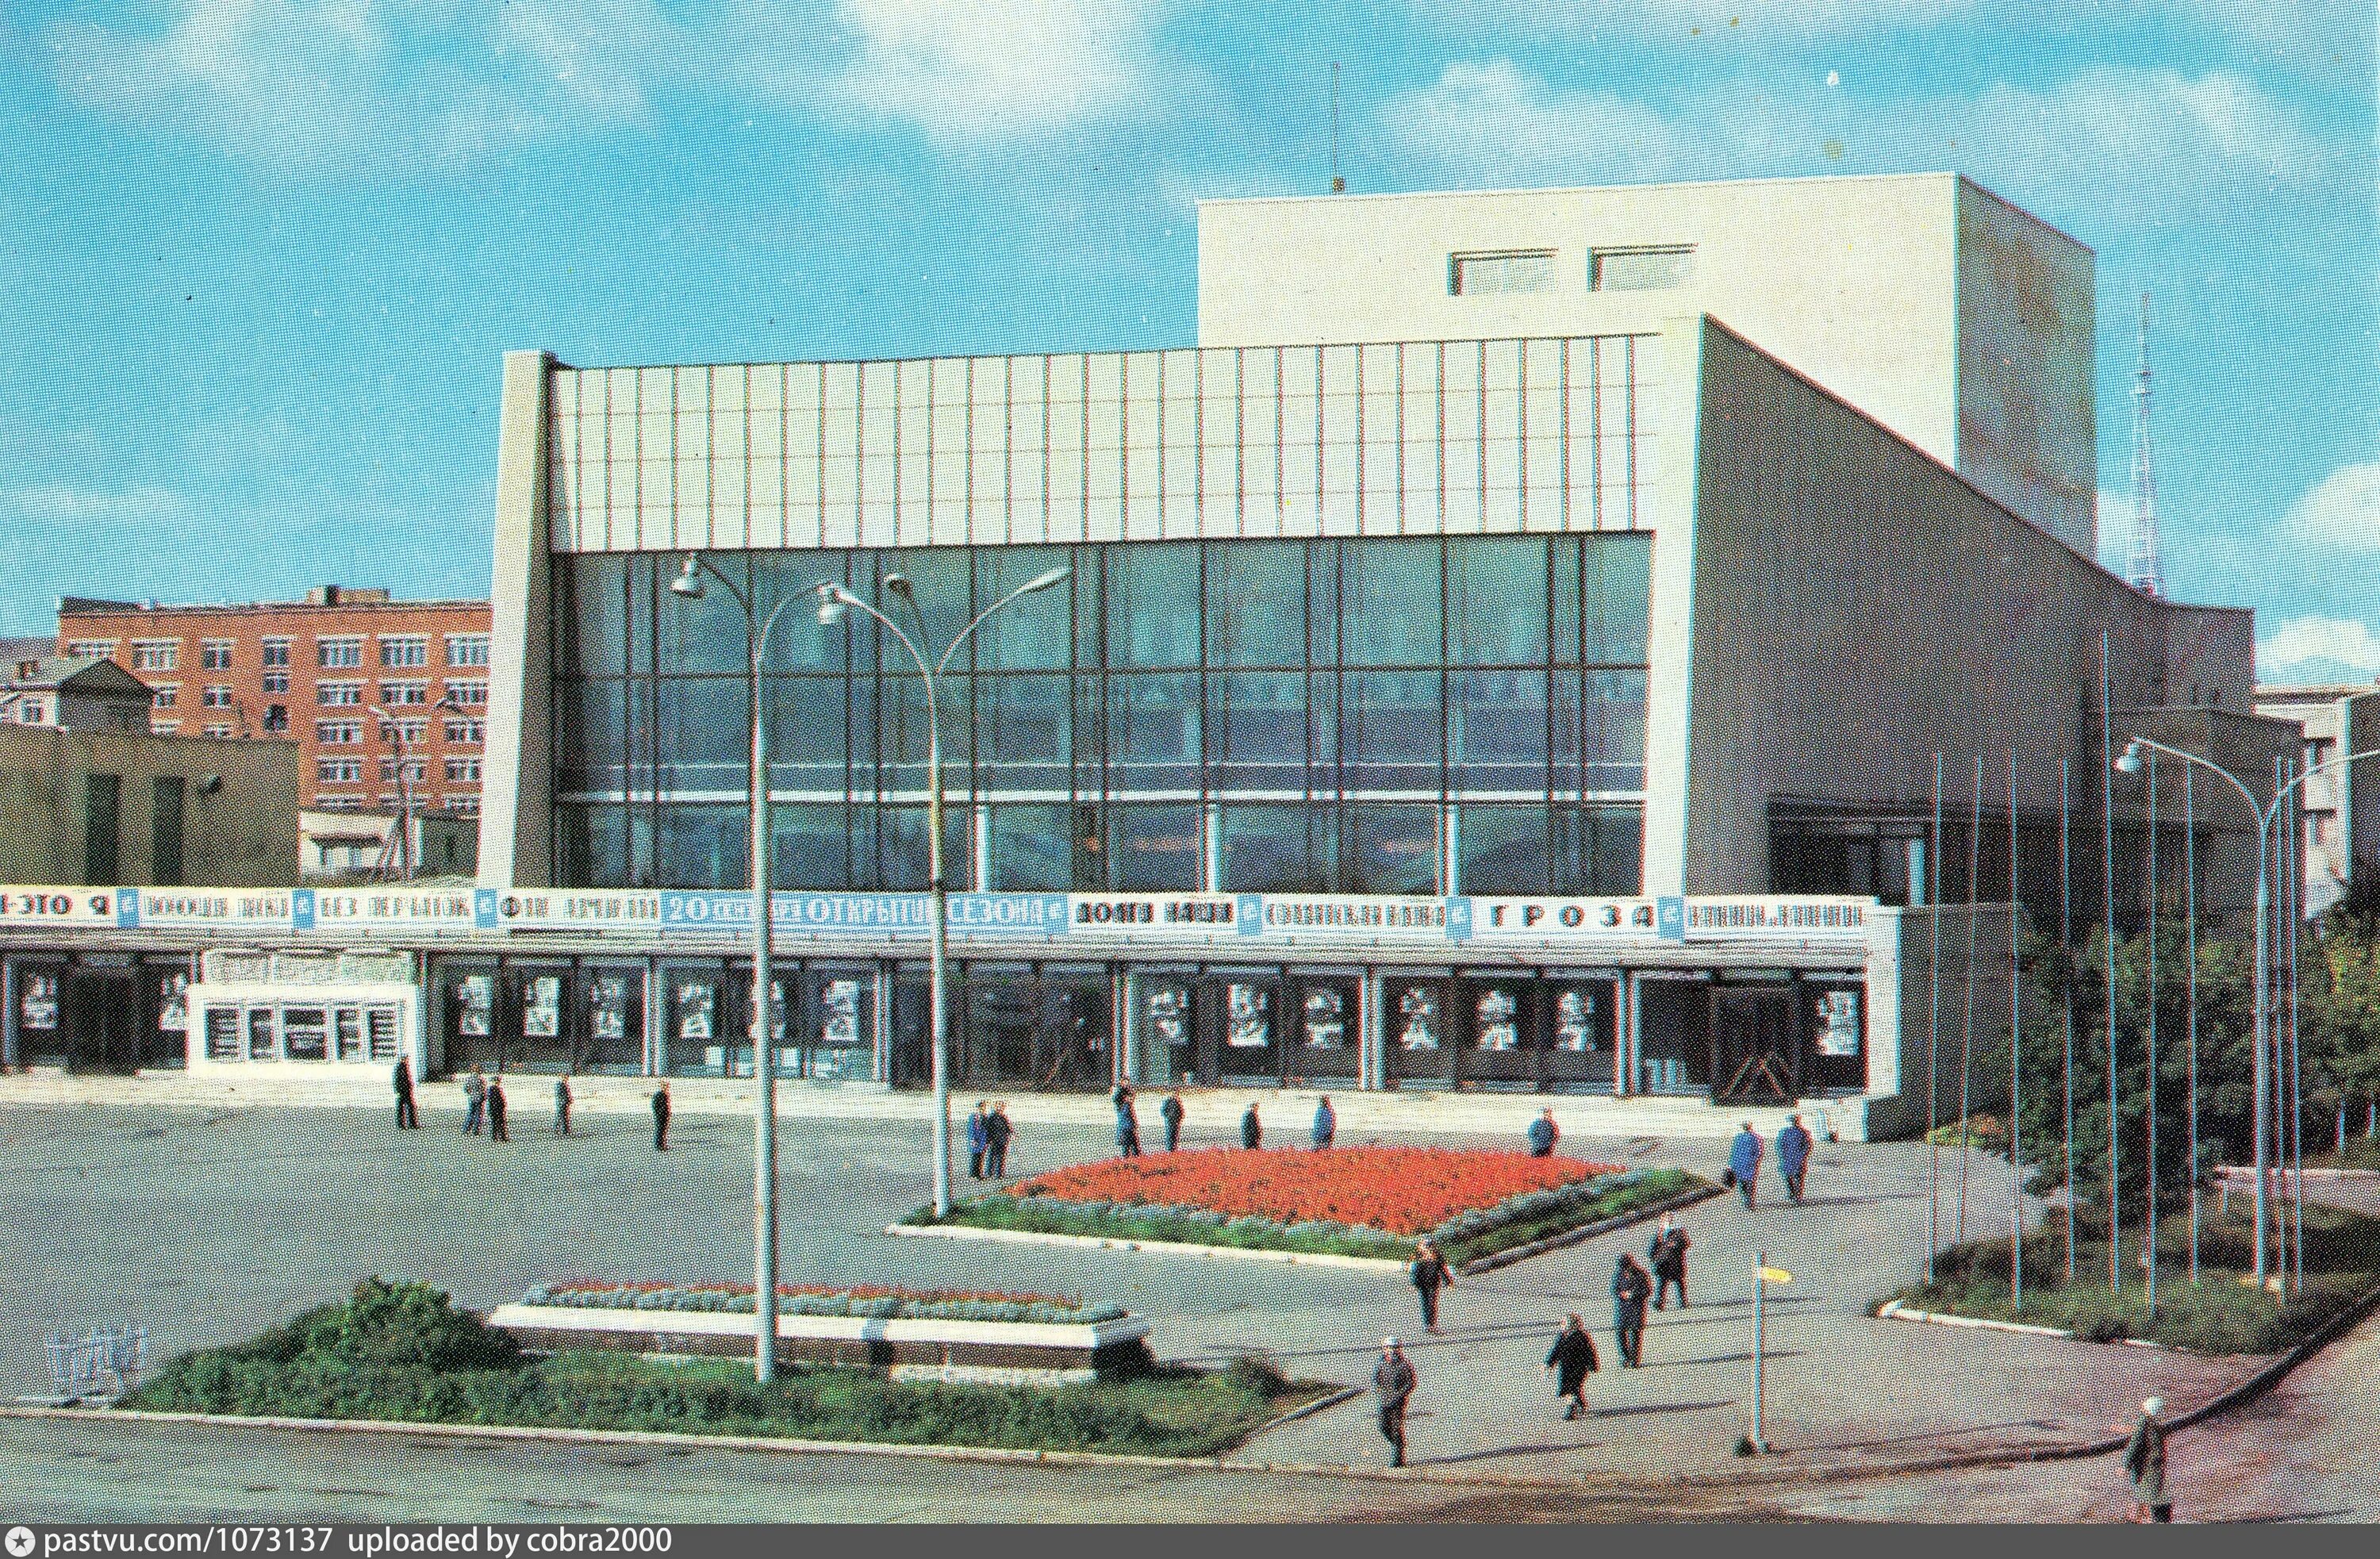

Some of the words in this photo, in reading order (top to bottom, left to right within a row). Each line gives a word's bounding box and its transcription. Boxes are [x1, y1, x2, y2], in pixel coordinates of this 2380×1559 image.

[89, 895, 111, 916] Я
[321, 897, 358, 917] БЕЗ
[670, 897, 709, 920] 20
[946, 899, 1043, 923] СЕЗОНА
[1076, 902, 1154, 923] ДОЛГИ
[1164, 902, 1234, 923] НАШИ
[1489, 904, 1654, 927] ГРОЗА
